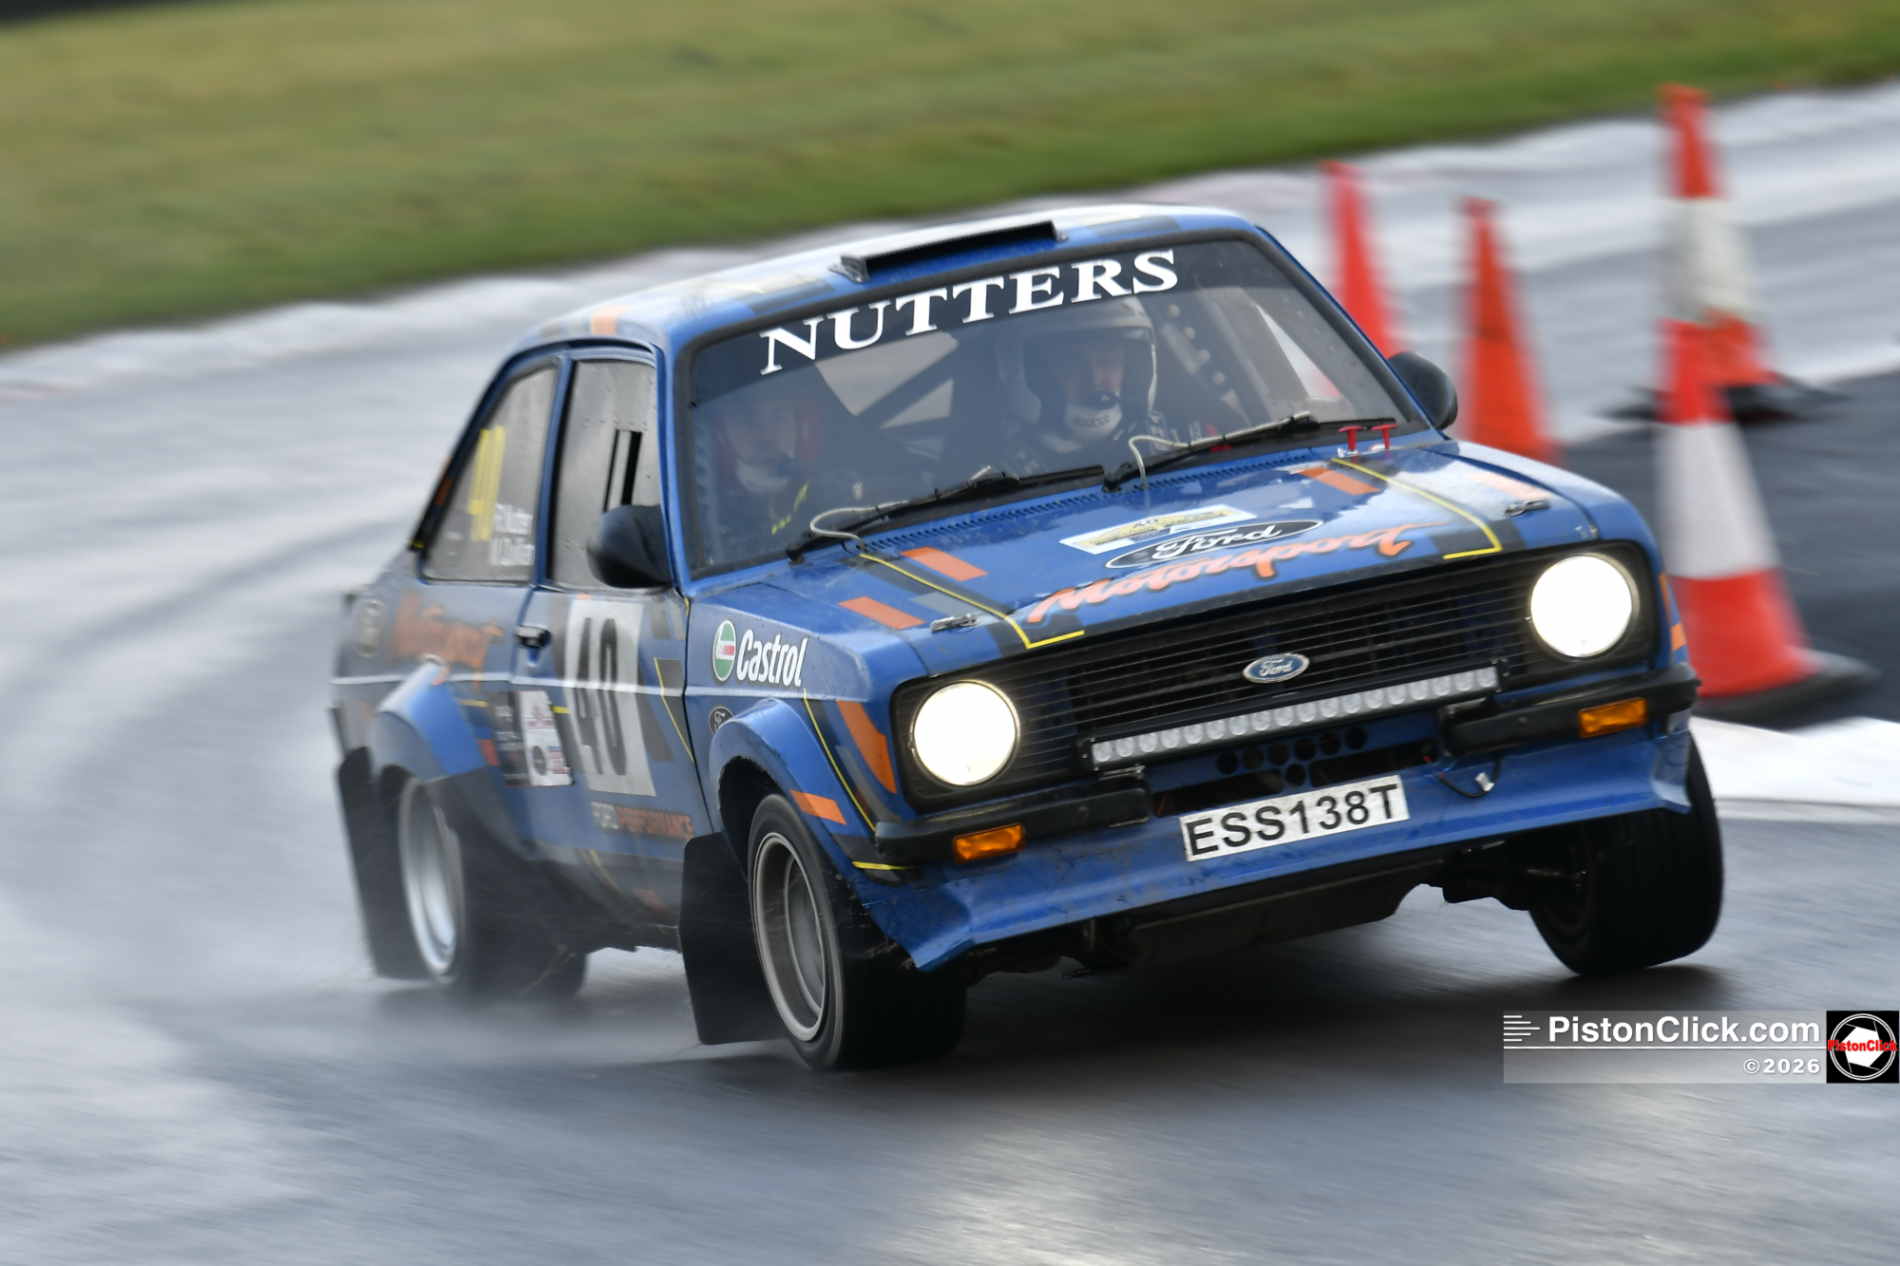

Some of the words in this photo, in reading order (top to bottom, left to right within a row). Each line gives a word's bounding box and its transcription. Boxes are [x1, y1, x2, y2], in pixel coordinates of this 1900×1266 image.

[760, 249, 1179, 376] NUTTERS
[1027, 521, 1449, 624] Motorsport
[1151, 524, 1283, 560] Ford
[736, 629, 808, 687] Castrol
[1259, 657, 1294, 677] Ford
[574, 616, 628, 777] 40
[1186, 783, 1398, 856] ESS138T
